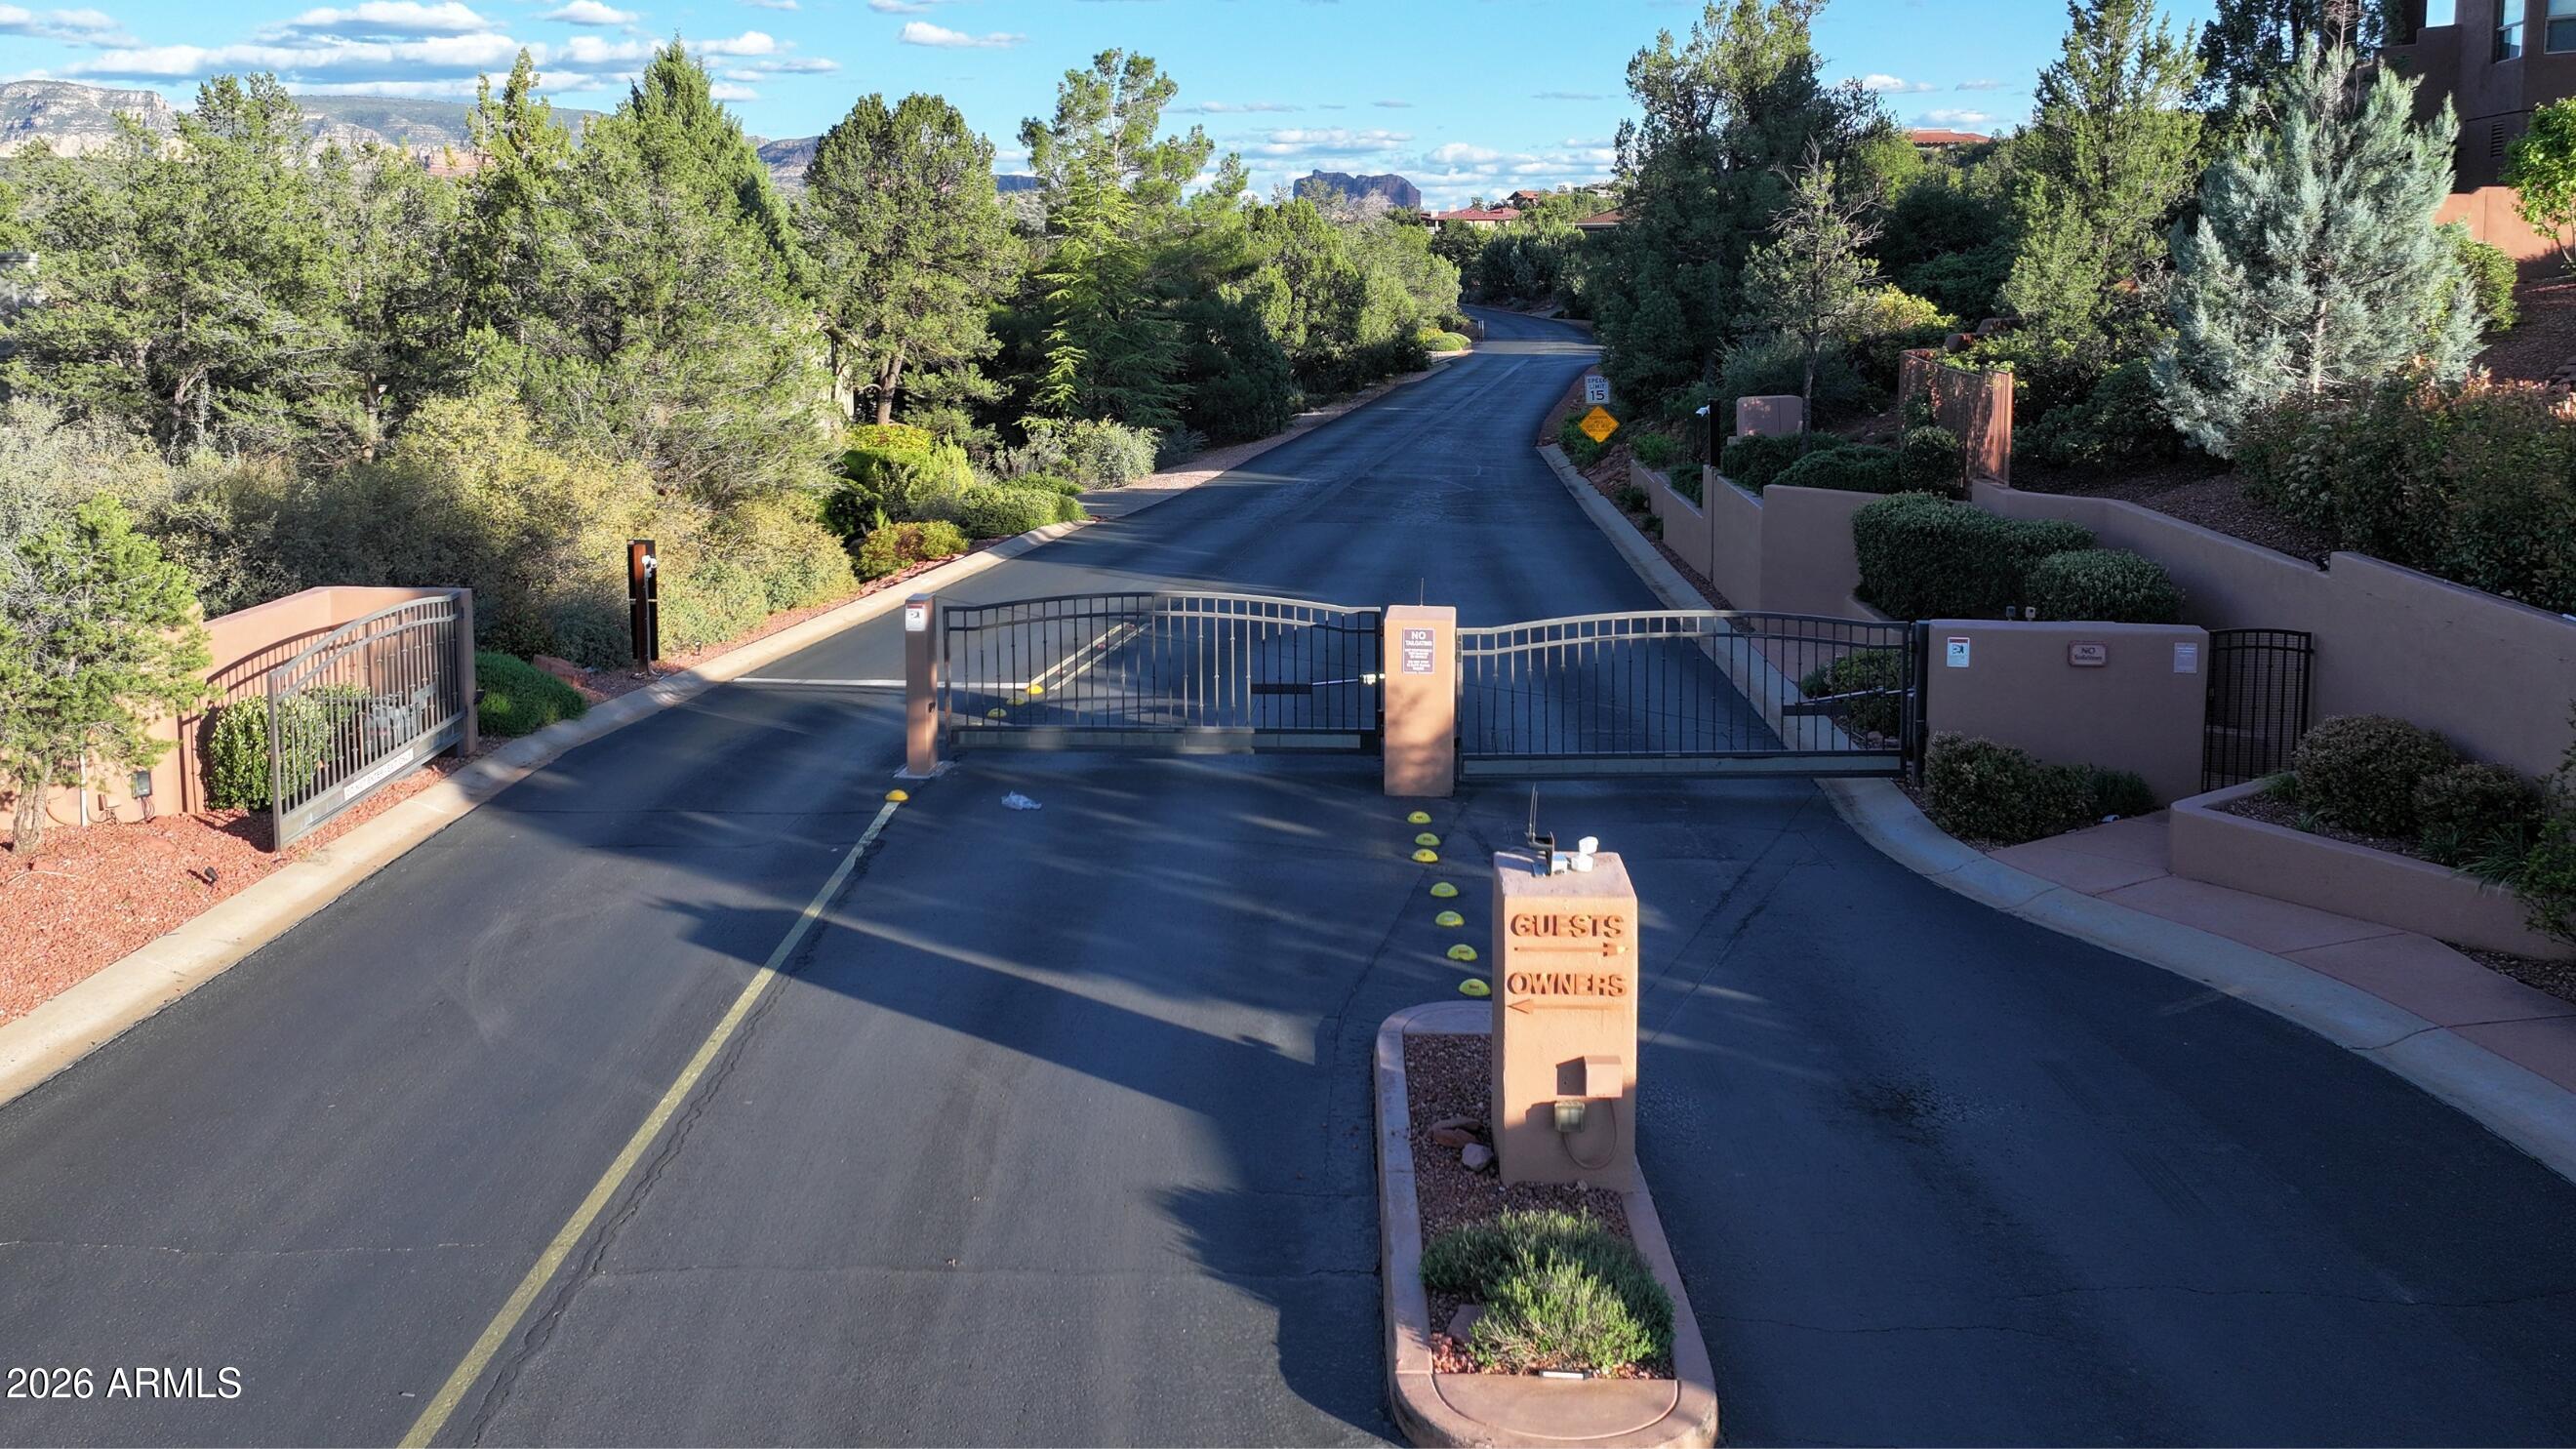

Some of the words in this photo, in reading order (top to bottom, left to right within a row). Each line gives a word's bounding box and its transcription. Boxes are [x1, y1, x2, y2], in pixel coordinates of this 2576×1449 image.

[1590, 390, 1605, 401] 15
[1411, 630, 1427, 640] NO
[1509, 913, 1624, 938] GUESTS
[1507, 972, 1628, 997] OWNERS
